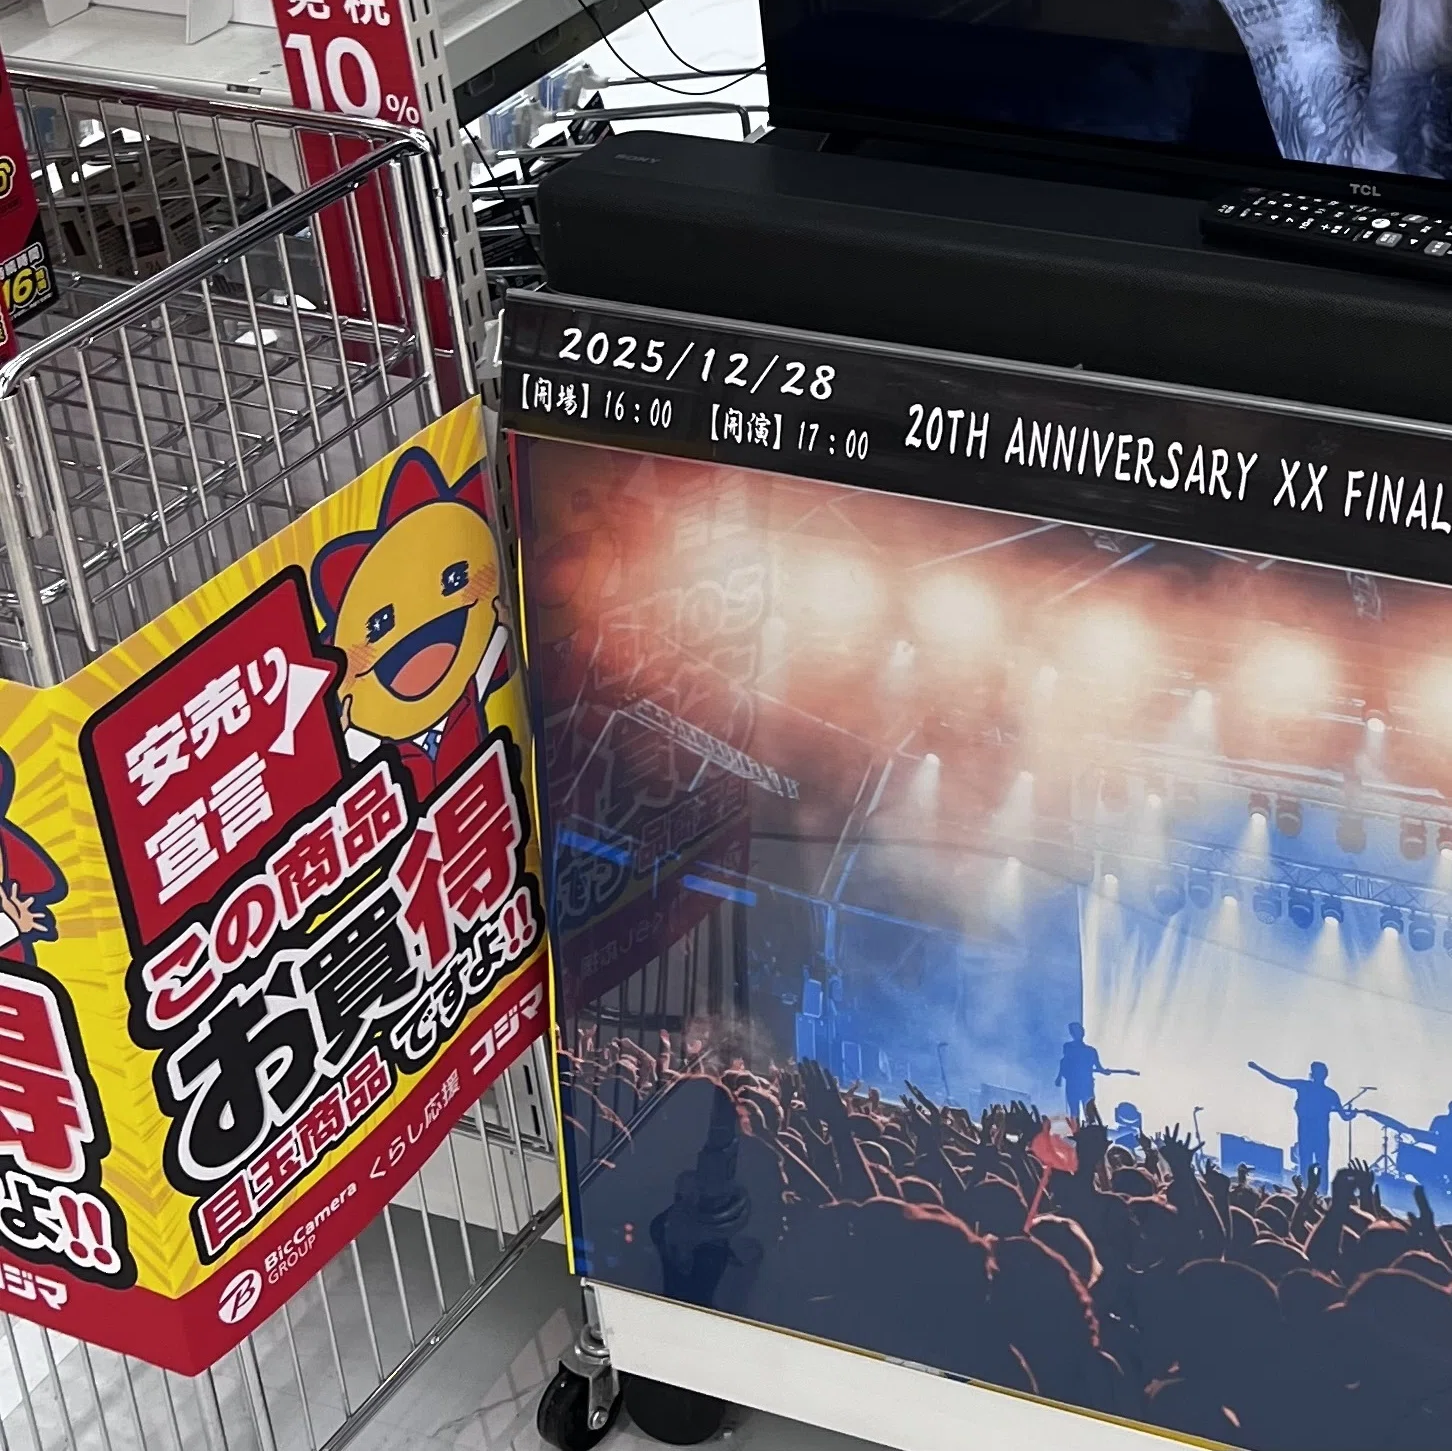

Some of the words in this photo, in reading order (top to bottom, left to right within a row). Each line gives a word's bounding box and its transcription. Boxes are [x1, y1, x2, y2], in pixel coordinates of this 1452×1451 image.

[1349, 183, 1381, 197] TCL
[558, 327, 837, 400] 2025/12/28
[904, 403, 990, 460] 20TH
[1004, 417, 1259, 502] ANNIVERSARY
[1273, 457, 1329, 513] XX
[1344, 470, 1452, 535] FINAL
[124, 646, 289, 807] 安売り
[144, 752, 274, 905] 宣言
[145, 761, 408, 1030] この商品
[200, 1045, 393, 1256] 目玉商品
[264, 1181, 358, 1272] BicCamera
[368, 1068, 462, 1180] くらし応援
[468, 981, 545, 1076] コジマ
[267, 1234, 317, 1285] GROUP
